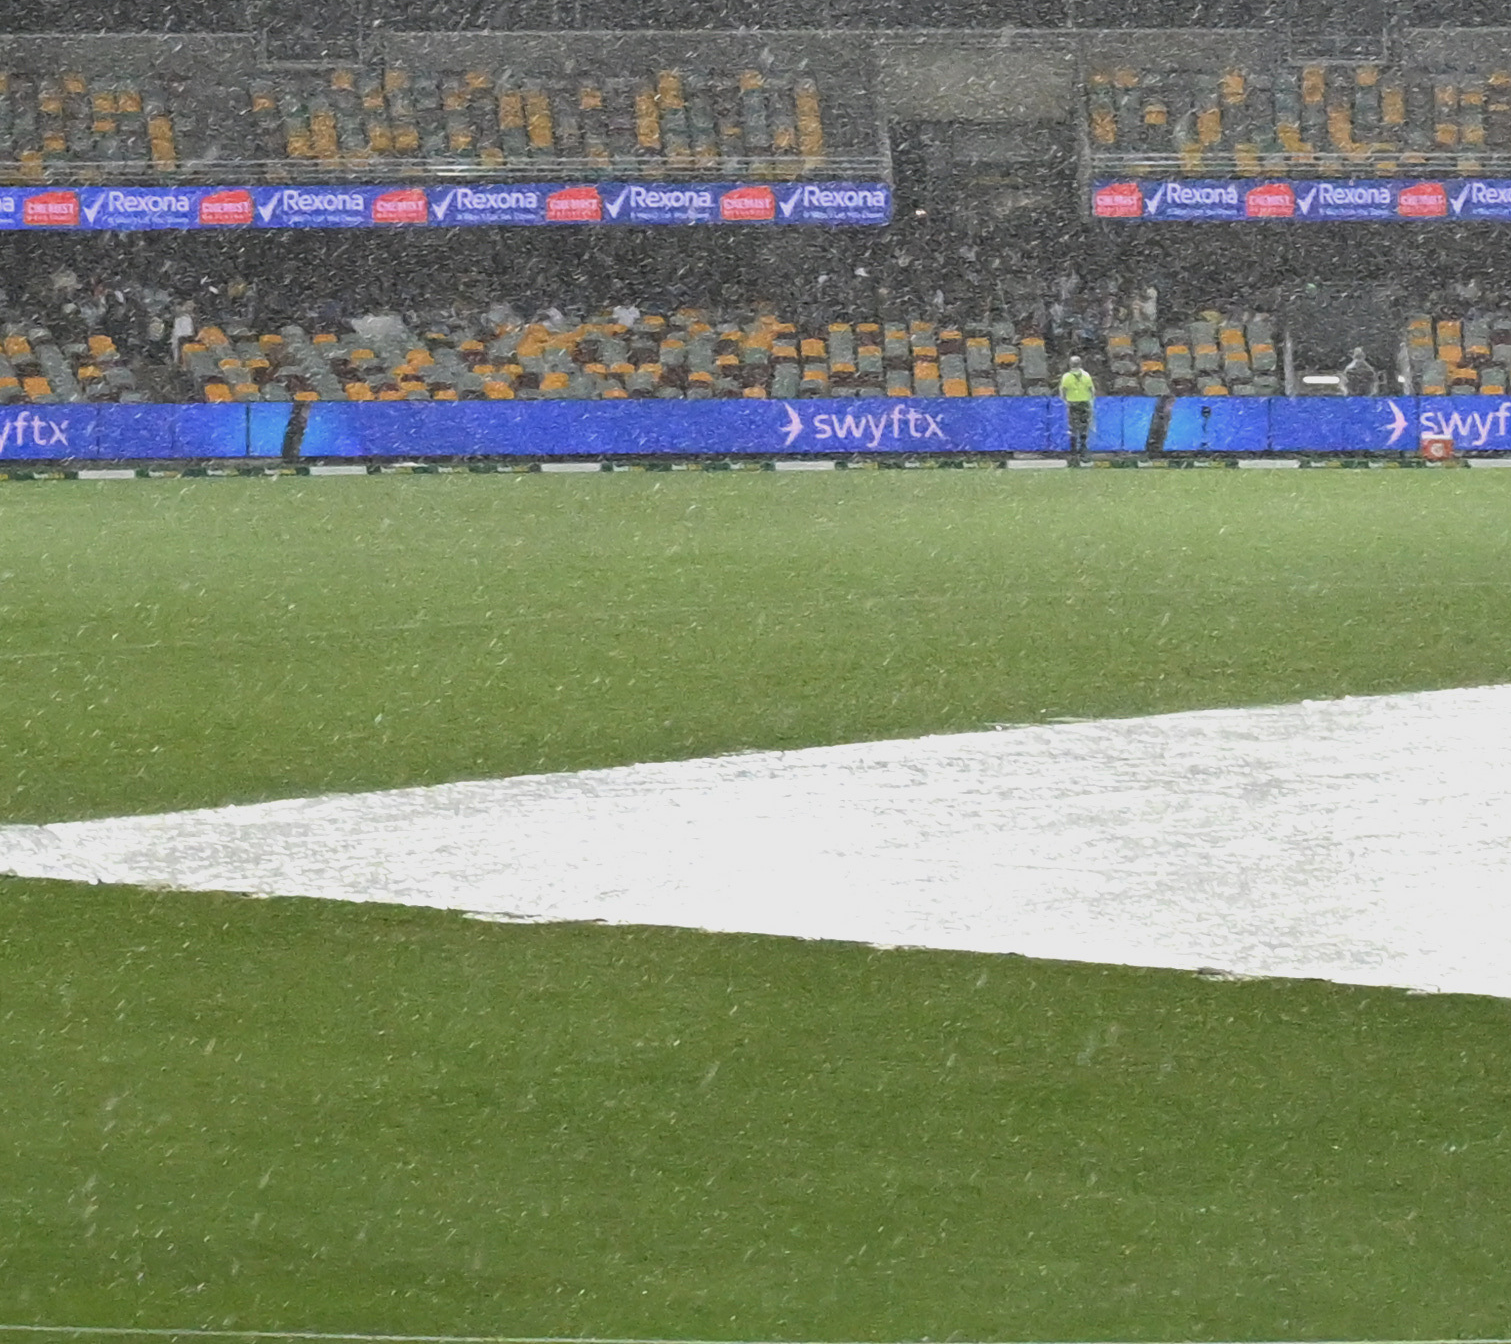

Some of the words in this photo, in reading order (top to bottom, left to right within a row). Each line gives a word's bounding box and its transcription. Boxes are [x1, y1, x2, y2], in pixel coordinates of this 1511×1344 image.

[109, 191, 189, 212] Rexona
[283, 190, 364, 211] Rexona
[457, 189, 537, 210] Rexona
[630, 186, 711, 206] Rexona
[803, 186, 885, 207] Rexona
[1167, 184, 1238, 204] Rexona
[1320, 184, 1391, 204] Rexona
[814, 405, 944, 448] swyftx
